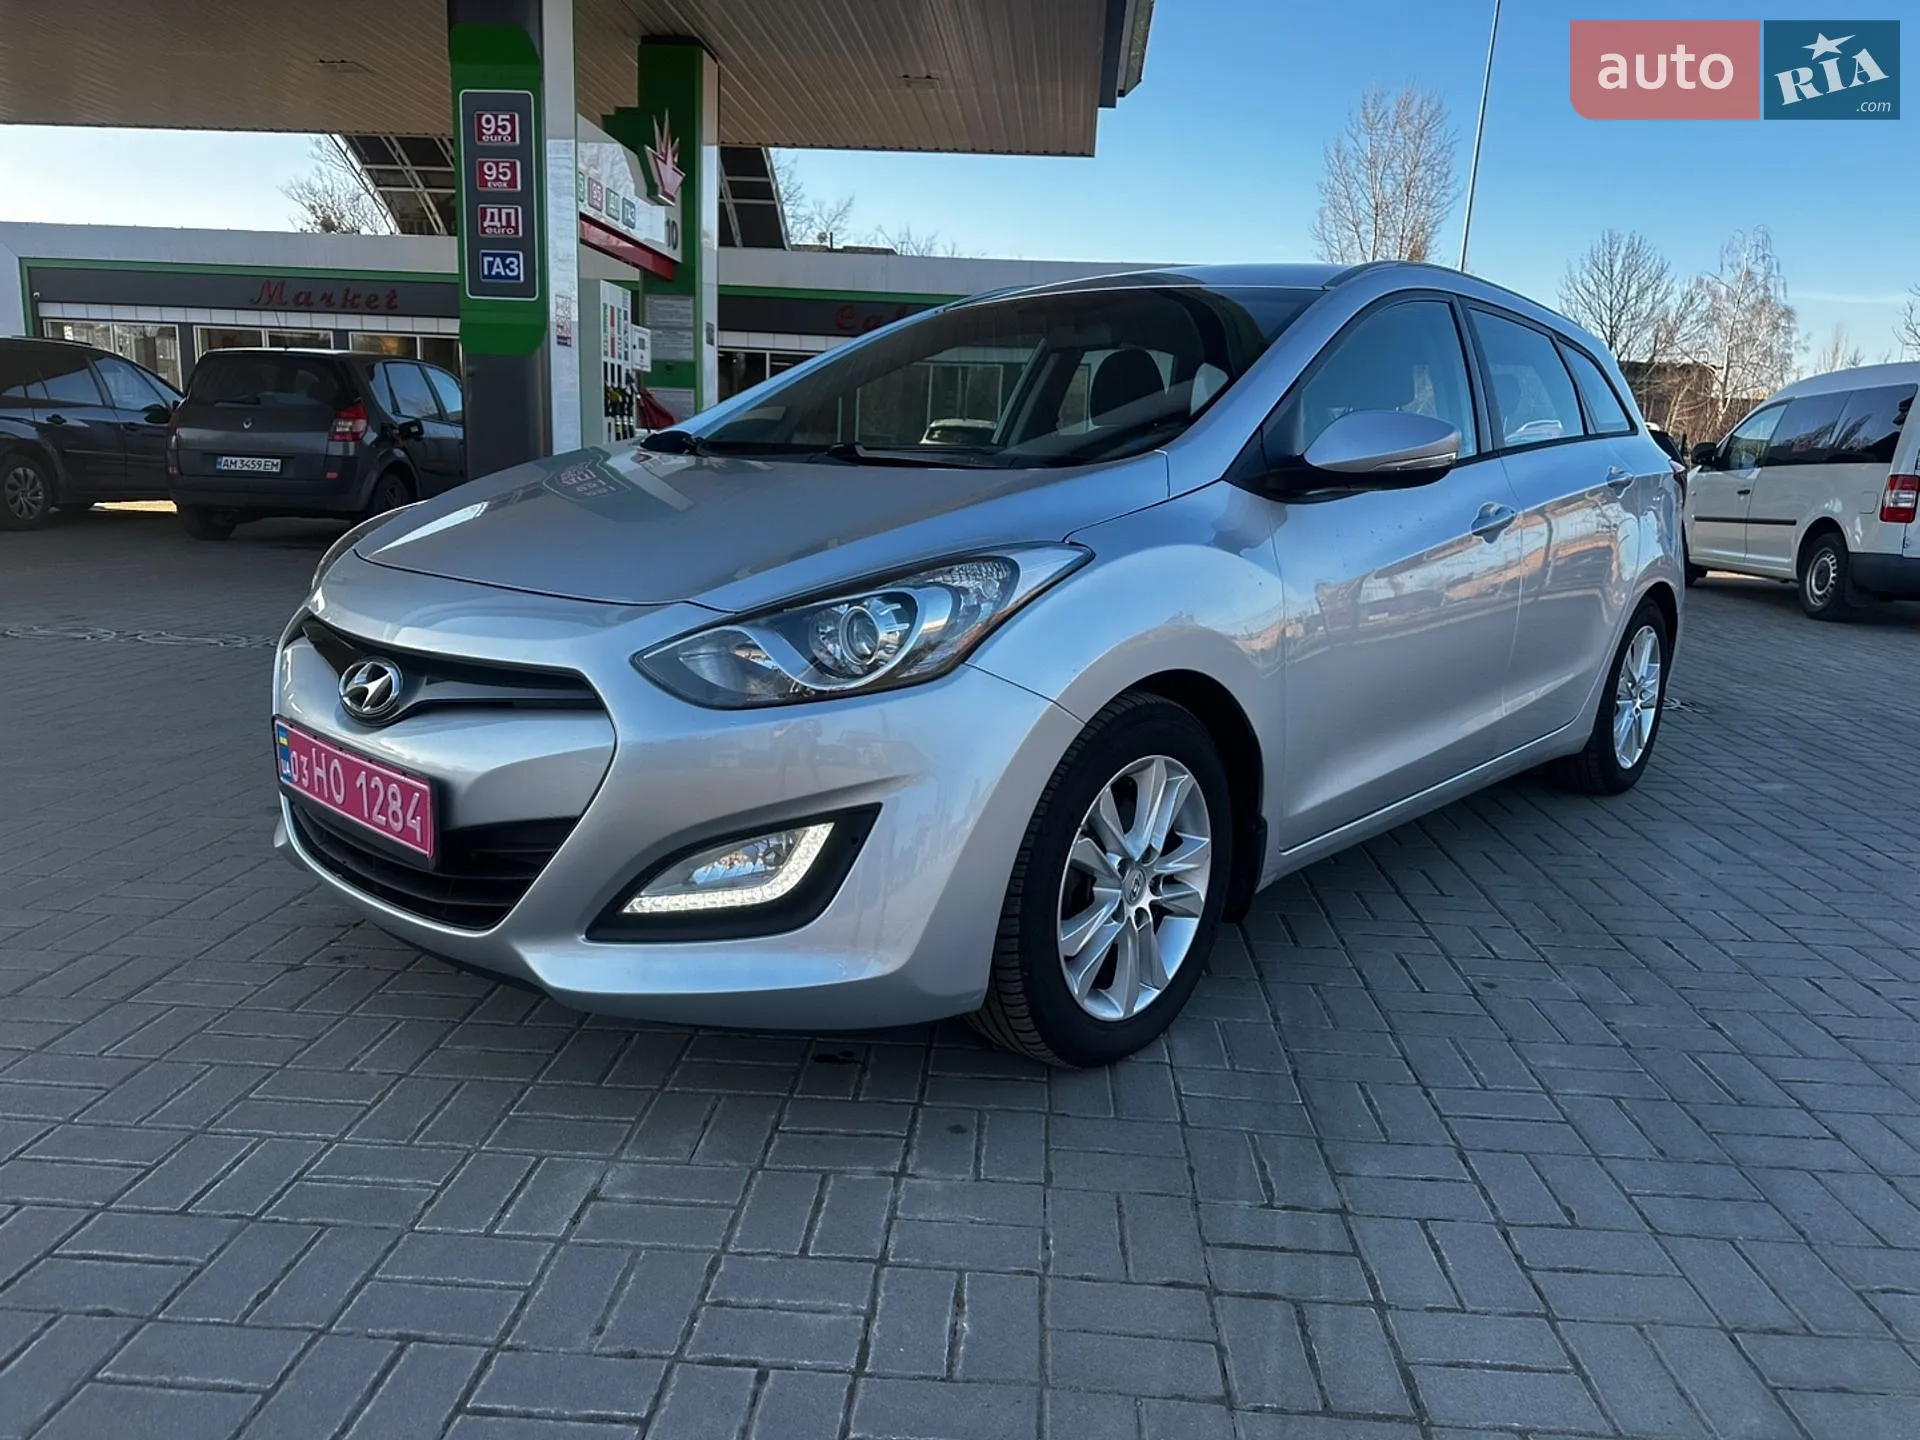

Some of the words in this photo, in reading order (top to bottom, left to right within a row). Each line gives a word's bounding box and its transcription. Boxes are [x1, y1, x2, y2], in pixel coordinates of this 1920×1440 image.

[481, 114, 511, 135] 95
[483, 162, 511, 180] 95
[483, 208, 516, 228] ДП
[485, 227, 515, 235] euro
[666, 218, 678, 250] 10
[483, 256, 519, 276] ГАЗ
[250, 279, 399, 310] Market
[356, 771, 422, 843] 1284
